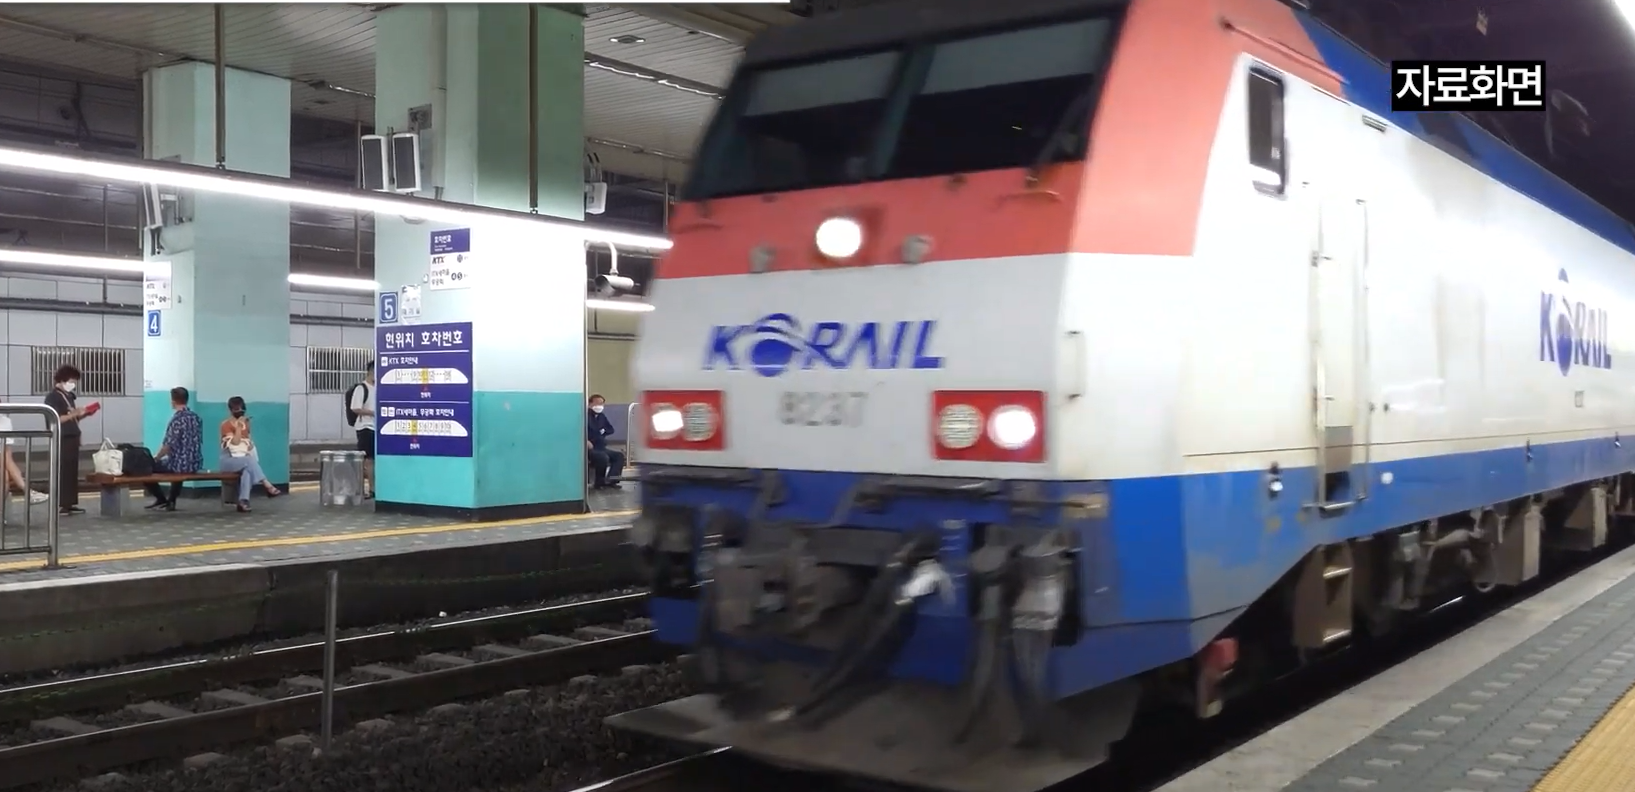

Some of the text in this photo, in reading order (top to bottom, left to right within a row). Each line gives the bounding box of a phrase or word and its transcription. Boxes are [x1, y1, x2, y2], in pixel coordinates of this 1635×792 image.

[432, 256, 445, 265] KTX
[384, 298, 394, 319] 5
[150, 314, 158, 333] 4
[1540, 268, 1612, 377] KORAIL
[385, 330, 463, 349] 현위치 호차번호
[702, 313, 946, 377] KORAIL
[388, 357, 400, 365] KTX
